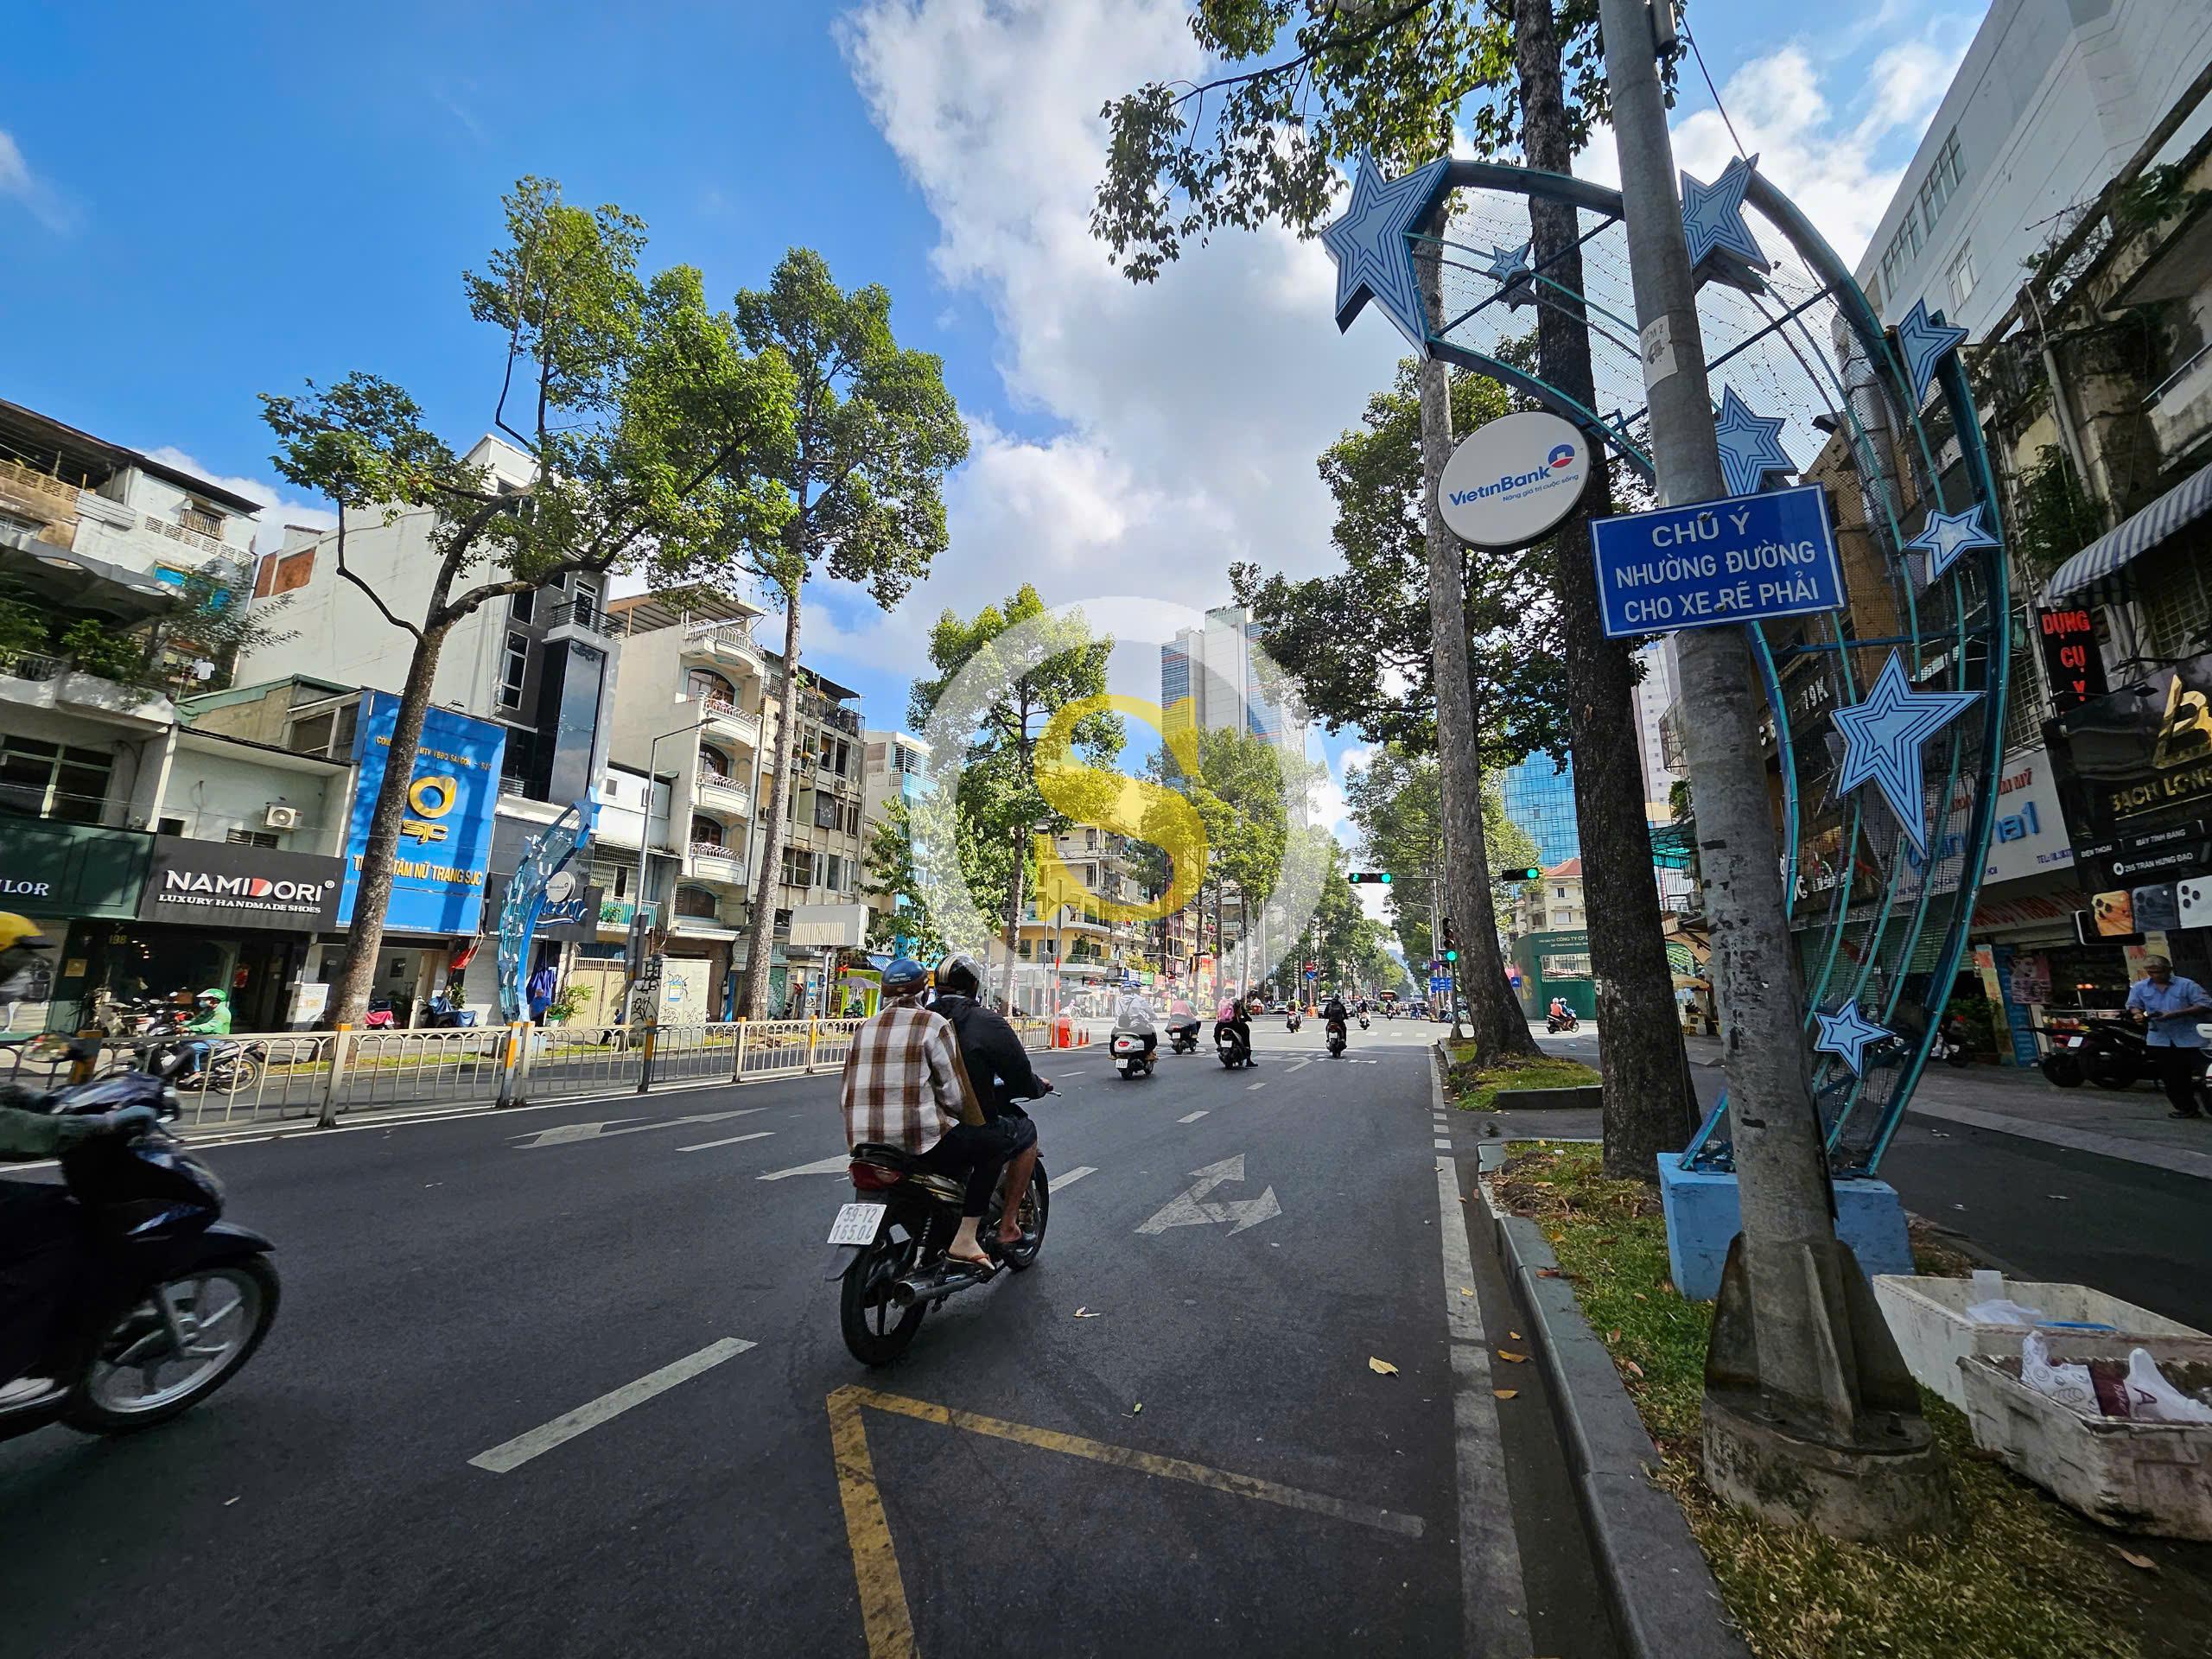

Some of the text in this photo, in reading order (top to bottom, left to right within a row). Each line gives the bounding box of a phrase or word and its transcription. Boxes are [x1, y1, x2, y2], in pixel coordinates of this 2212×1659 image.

[1449, 467, 1551, 505] VietinBank
[1729, 505, 1751, 536] Ý
[1615, 539, 1815, 588] NHƯỜNG ĐƯỜNG
[1624, 570, 1820, 623] CHO XE RẼ PHẢI
[165, 869, 323, 902] NAMIDORI
[431, 865, 463, 884] TRANG
[465, 869, 482, 886] SJC
[158, 893, 321, 913] LUXURY HANDMADE SHOES
